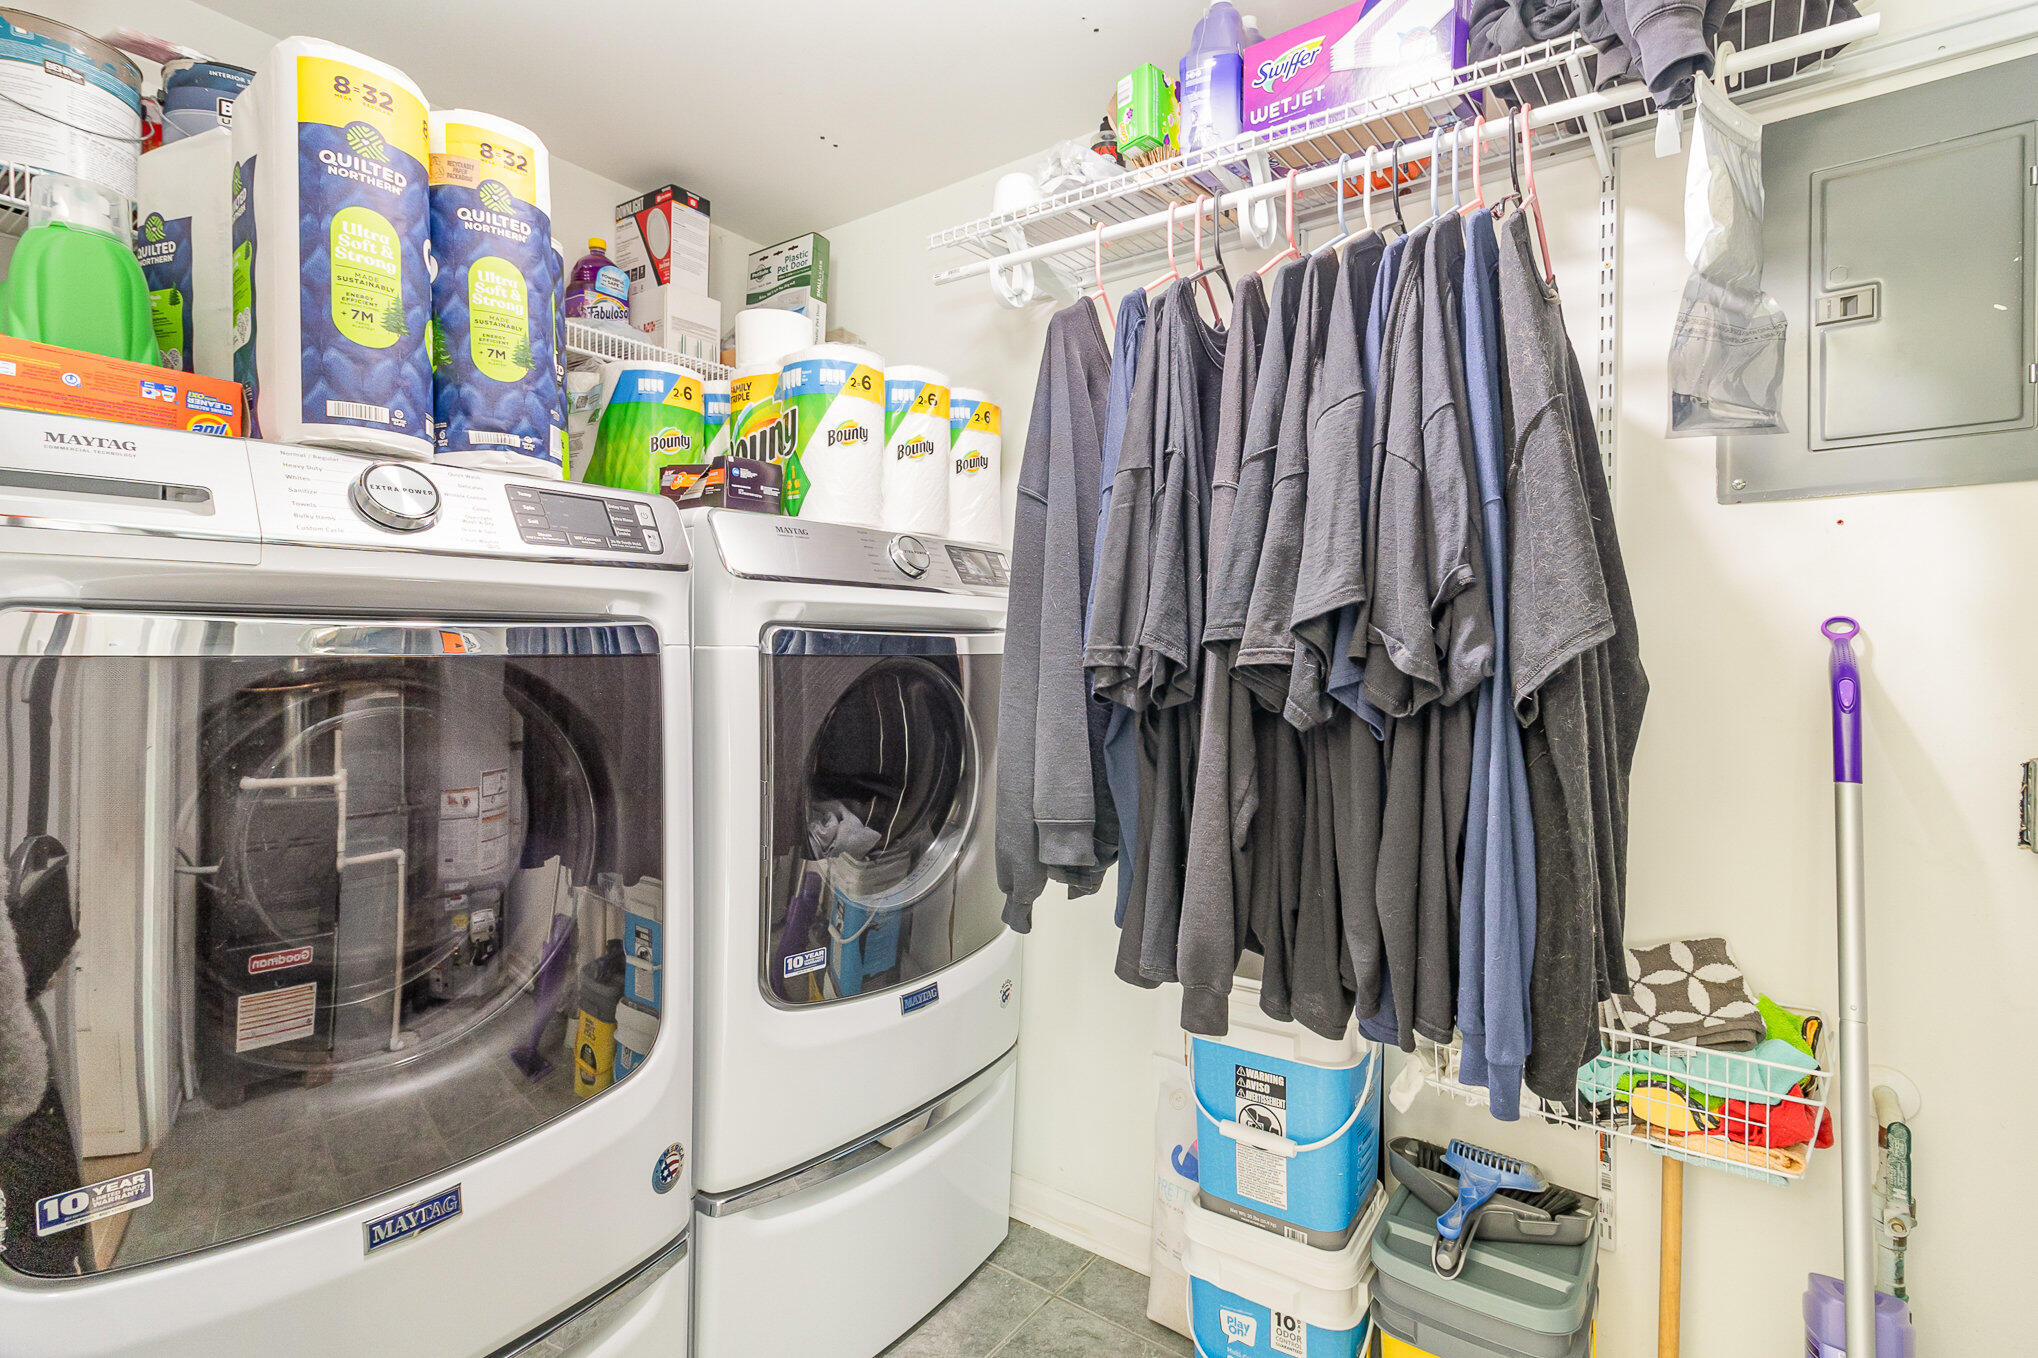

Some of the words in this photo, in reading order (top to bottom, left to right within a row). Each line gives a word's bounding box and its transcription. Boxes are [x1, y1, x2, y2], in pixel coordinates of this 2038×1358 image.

[209, 70, 244, 82] INTERIOR
[1253, 49, 1320, 86] Swiffer
[1250, 84, 1326, 125] WETJET
[318, 149, 408, 188] QUILTED
[327, 166, 399, 194] NORTHERN
[456, 207, 532, 236] QUILTED
[342, 221, 390, 245] Ultra
[464, 221, 527, 243] NORTHERN
[338, 234, 378, 254] Soft
[380, 245, 394, 260] &
[785, 250, 808, 263] Plastic
[335, 246, 397, 275] Strong
[777, 265, 788, 274] Pet
[791, 259, 808, 269] Door
[336, 275, 395, 293] SUSTAINABLY
[477, 270, 518, 290] Ultra
[474, 282, 508, 297] Soft
[511, 287, 522, 302] &
[472, 293, 524, 315] Strong
[587, 306, 629, 319] Fabuloso
[474, 318, 523, 332] SUSTAINABLY
[186, 397, 233, 411] CLEANER
[45, 432, 137, 452] MAYTAG
[650, 434, 690, 453] Bounty
[828, 426, 869, 447] Bounty
[44, 444, 91, 454] COMMERCIAL
[94, 449, 137, 459] TECHNOLOGY
[897, 440, 934, 461] Bounty
[956, 456, 989, 475] Bounty
[285, 474, 311, 482] Whites
[288, 487, 318, 495] Sanitize
[369, 484, 400, 493] EXTRA
[402, 487, 433, 496] POWER
[291, 500, 317, 508] Towels
[775, 526, 809, 536] MAYTAG
[786, 956, 804, 971] 10
[904, 988, 937, 1009] MAYTAG
[1245, 1067, 1285, 1086] WARNING
[1245, 1079, 1270, 1094] AVISO
[92, 1174, 146, 1196] YEAR
[43, 1191, 89, 1222] 10
[92, 1188, 146, 1208] WARRANTY
[372, 1195, 458, 1244] MAYTAG
[1275, 1312, 1296, 1332] 10
[1275, 1336, 1303, 1350] CONTROL
[1276, 1328, 1303, 1344] ODOR
